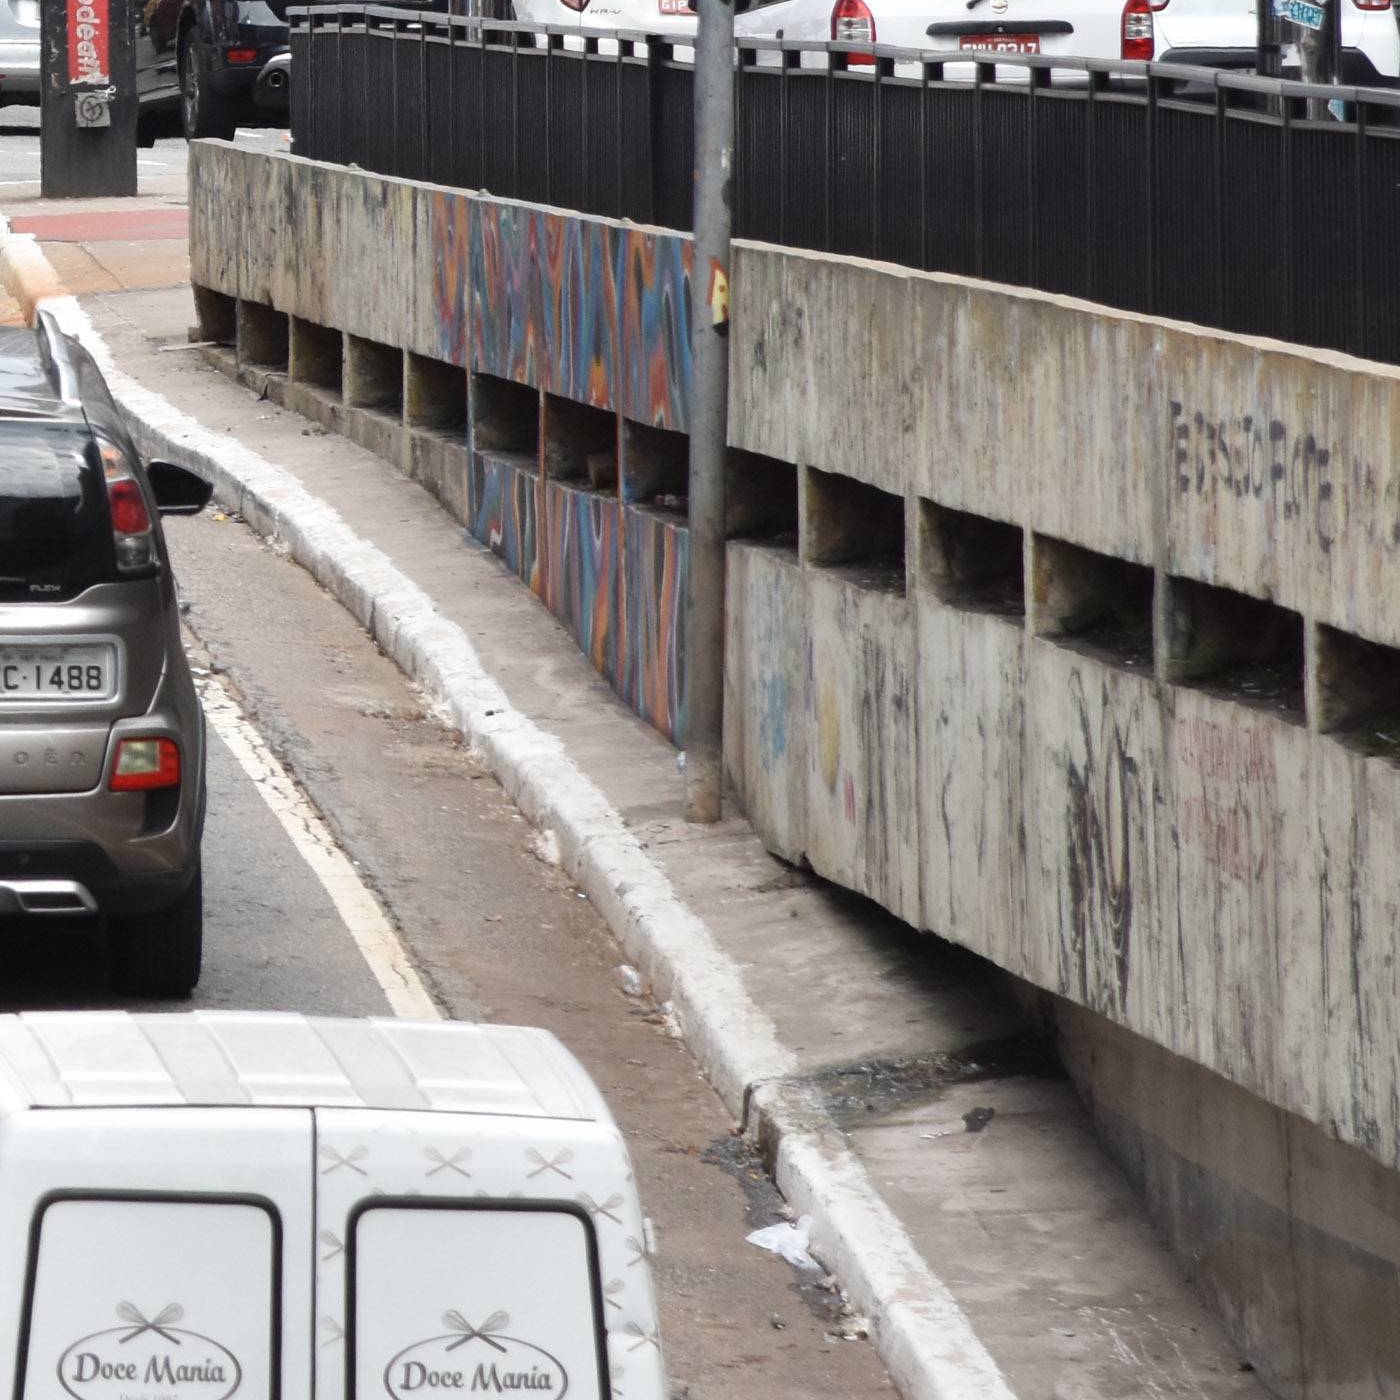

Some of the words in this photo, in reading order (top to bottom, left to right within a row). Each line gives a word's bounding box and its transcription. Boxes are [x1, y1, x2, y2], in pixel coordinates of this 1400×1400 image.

[72, 1352, 137, 1383] Doce
[143, 1354, 226, 1386] Mania
[399, 1360, 464, 1391] Doce
[470, 1362, 553, 1393] Mania
